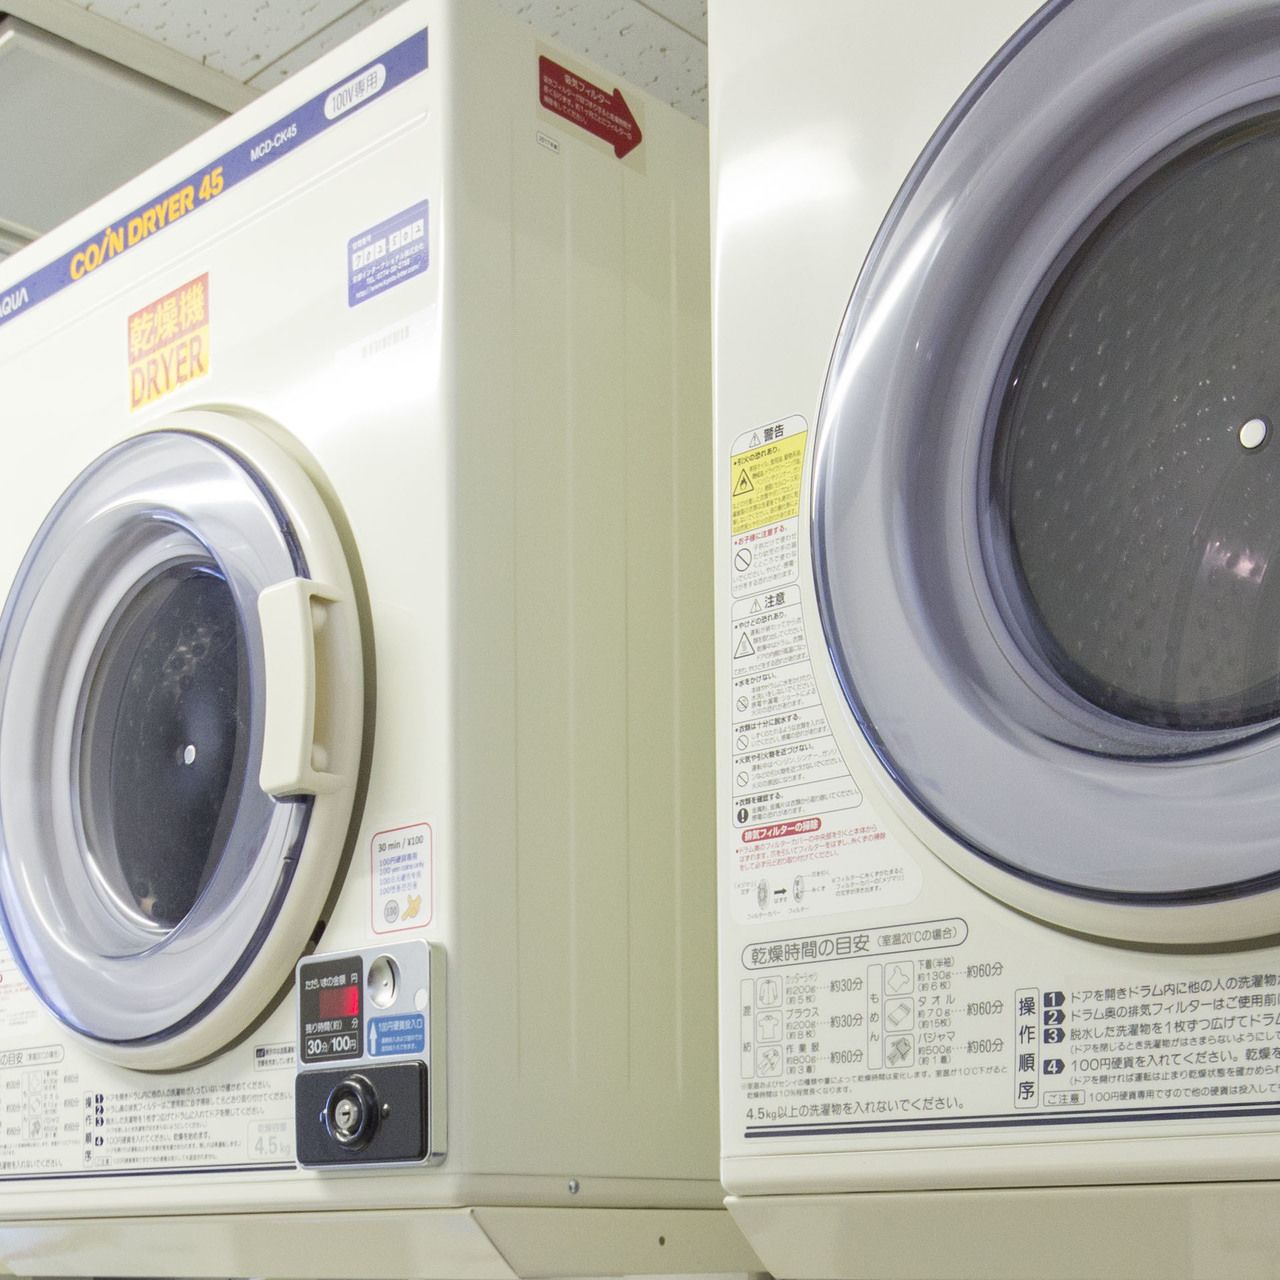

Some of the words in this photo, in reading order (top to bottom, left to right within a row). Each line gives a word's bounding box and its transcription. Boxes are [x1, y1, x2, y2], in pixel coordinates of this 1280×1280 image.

[333, 71, 378, 112] 100V専用
[250, 124, 297, 162] MCD-CK45
[127, 185, 194, 247] DRYER
[199, 167, 224, 201] 45
[130, 281, 205, 355] 乾燥機
[131, 334, 204, 409] DRYER
[764, 424, 784, 442] 警告
[764, 592, 785, 608] 注意
[745, 819, 819, 841] 排気フィルターの掃除
[751, 934, 870, 966] 乾燥時間の目安
[351, 973, 358, 983] 円
[967, 961, 1004, 978] 約60分
[830, 977, 863, 993] 約30分
[918, 994, 956, 1007] タオル
[967, 1000, 1004, 1016] 約60分
[786, 1008, 820, 1019] ブラウス
[830, 1013, 863, 1029] 約30分
[870, 993, 880, 1042] もめん
[352, 1018, 358, 1028] 分
[308, 1036, 357, 1054] 30分/100円
[967, 1038, 1004, 1054] 約60分
[1018, 997, 1037, 1100] 操作順序
[830, 1049, 863, 1064] 約60分
[1047, 1094, 1079, 1105] ご注意
